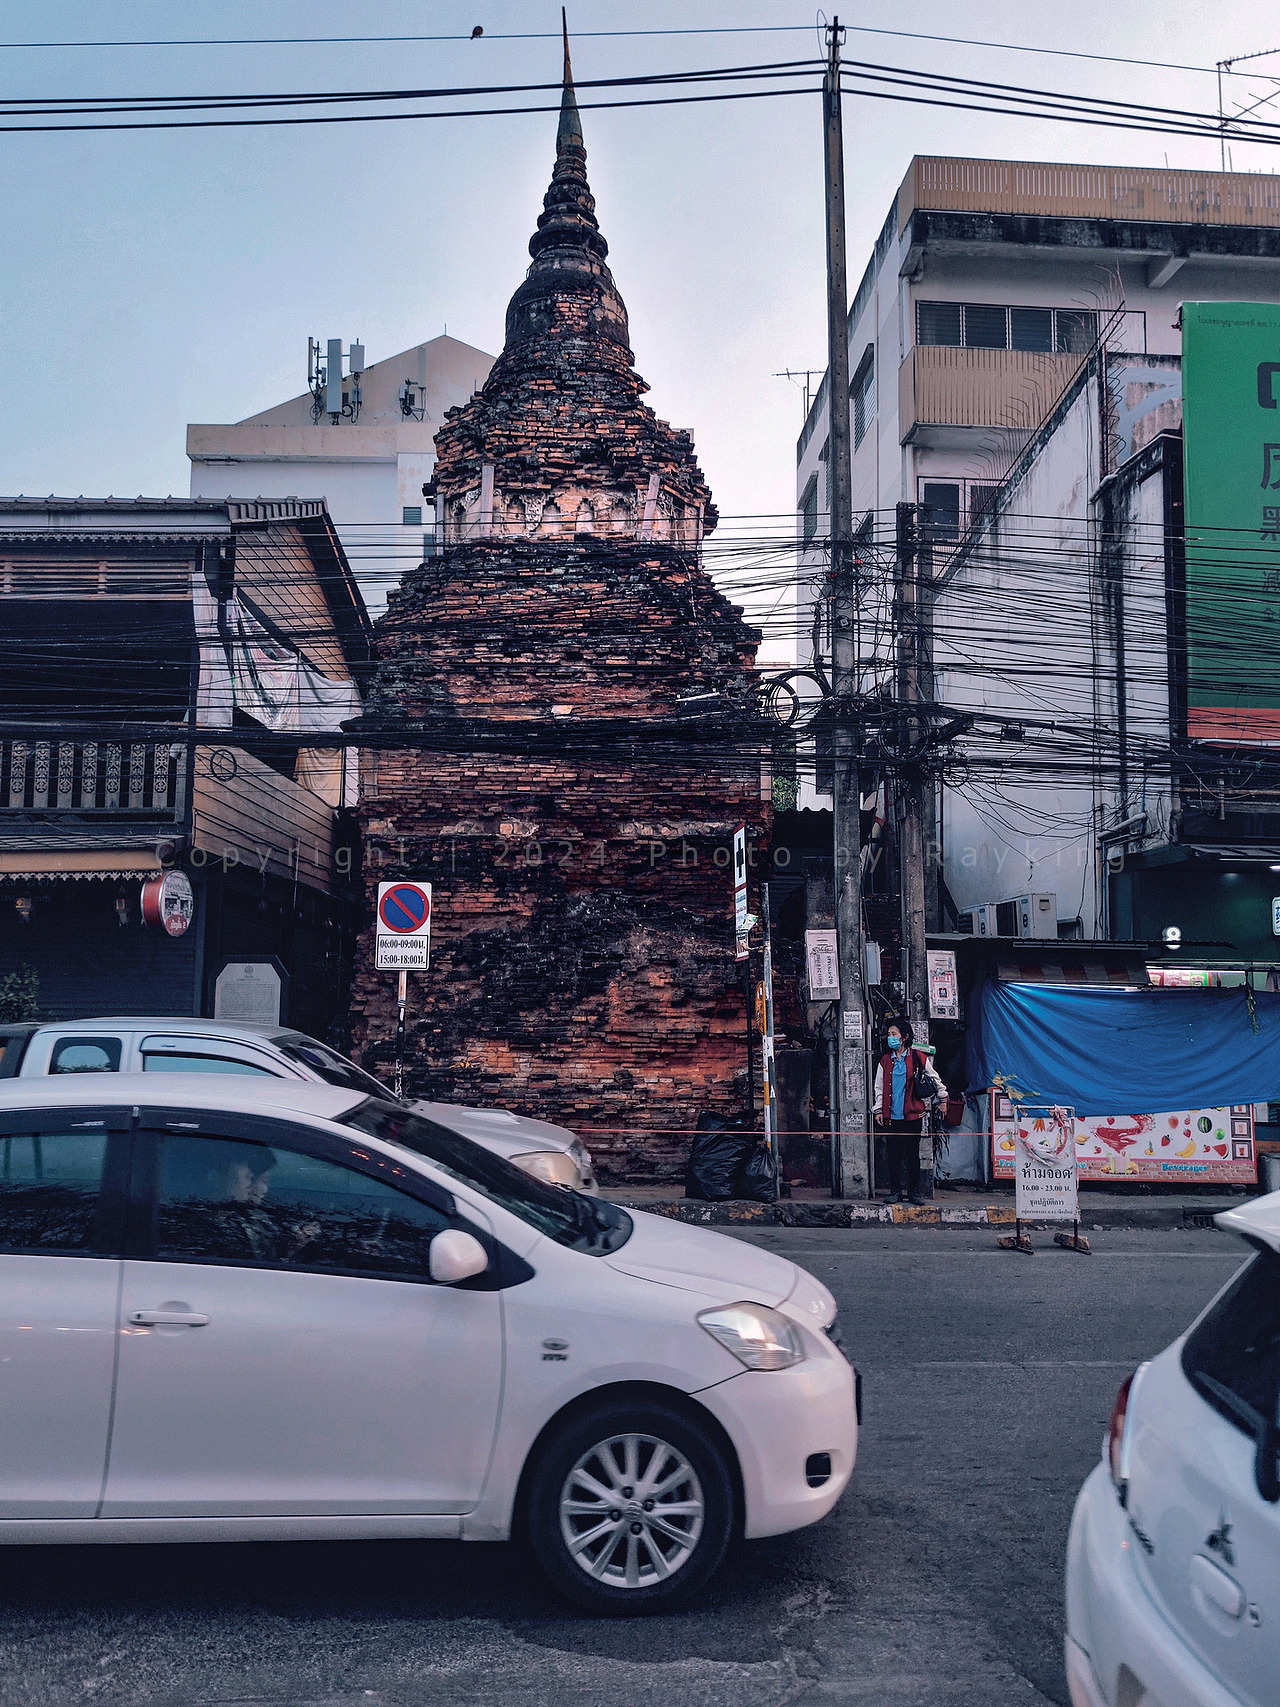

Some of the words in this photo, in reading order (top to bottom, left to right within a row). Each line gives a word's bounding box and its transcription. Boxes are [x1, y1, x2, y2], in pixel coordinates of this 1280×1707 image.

[1022, 1162, 1072, 1179] ห้ามจอด
[1162, 1163, 1208, 1173] Beverages
[1022, 1184, 1039, 1192] 16.00
[1045, 1184, 1062, 1192] 23.00
